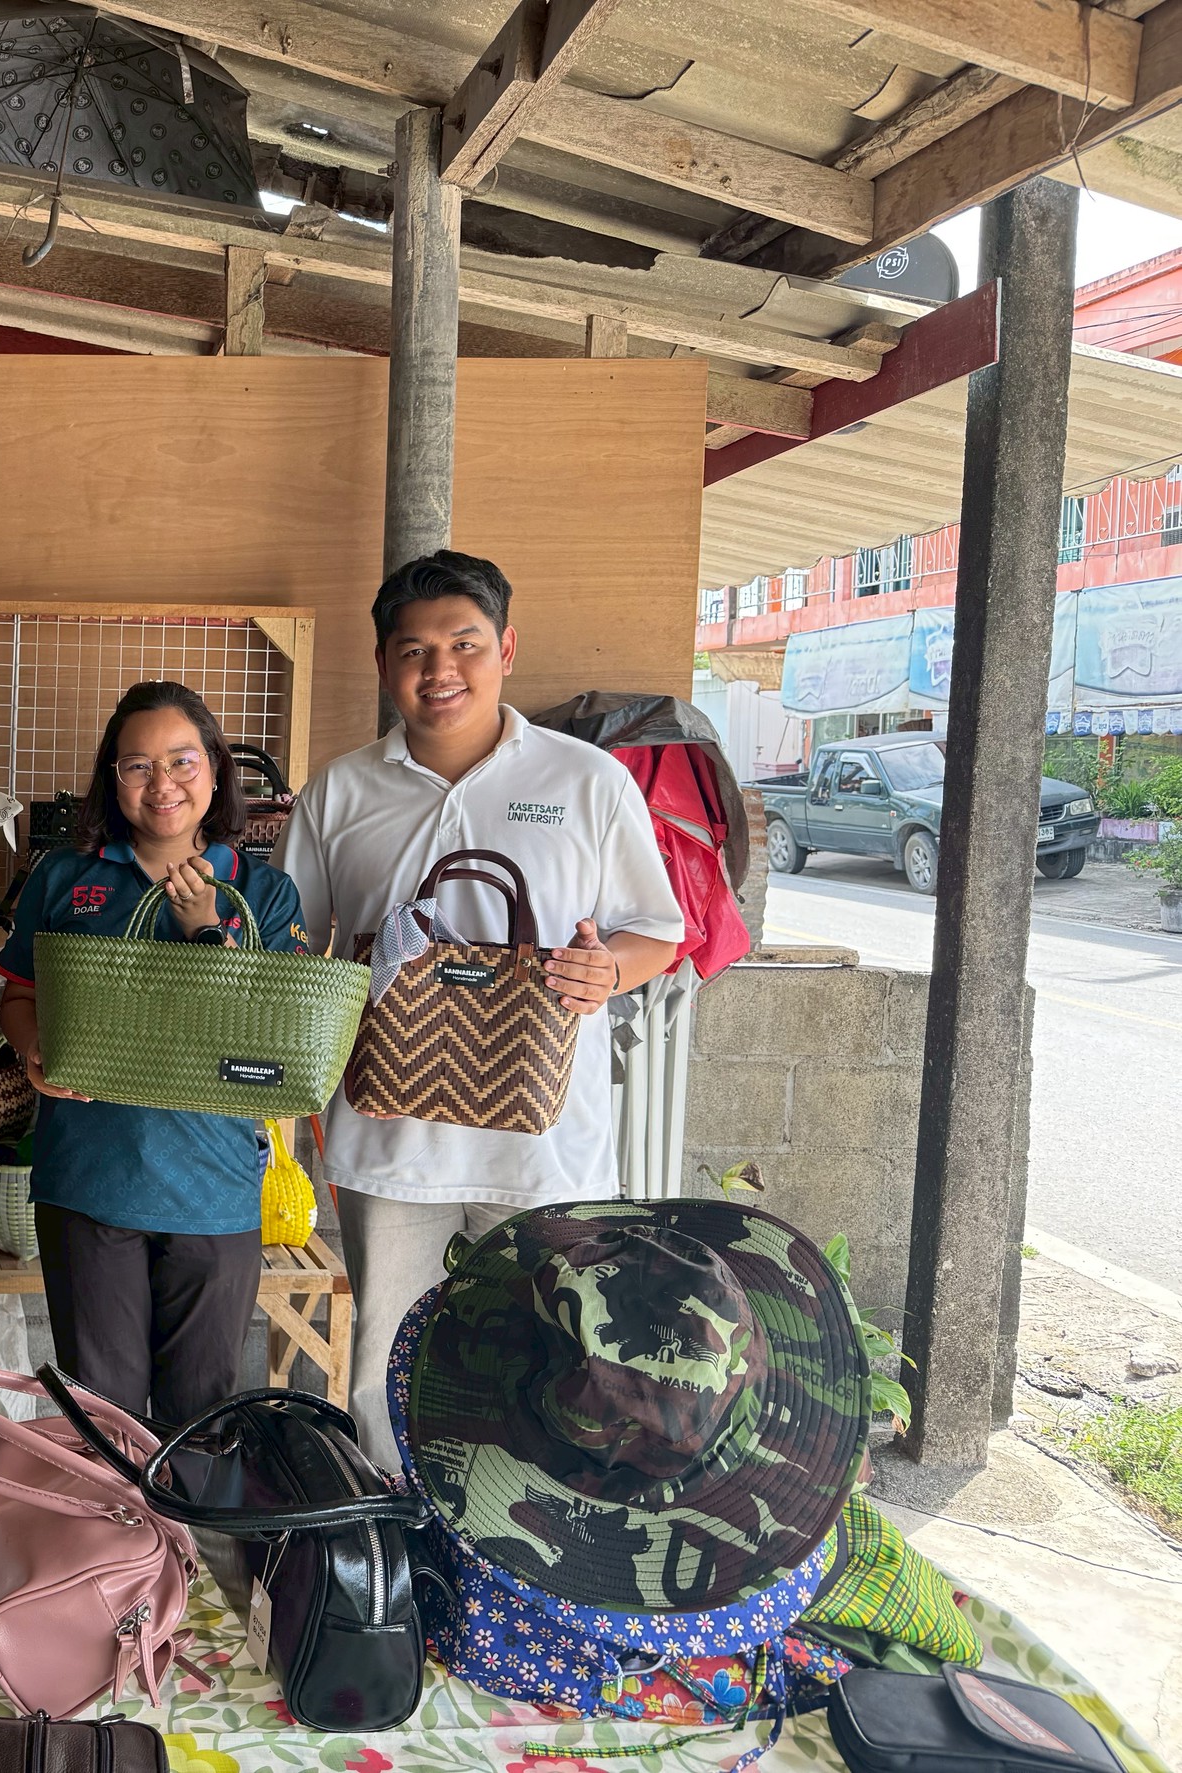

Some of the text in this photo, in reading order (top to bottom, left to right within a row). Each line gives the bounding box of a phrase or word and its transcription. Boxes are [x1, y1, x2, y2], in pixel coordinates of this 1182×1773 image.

[885, 258, 901, 267] PSI
[508, 802, 565, 815] KASETSART
[507, 812, 564, 825] UNIVERSITY
[74, 905, 100, 915] DOAE
[443, 967, 487, 978] BANNAILEAM
[230, 1064, 275, 1075] BANNAILEAM
[154, 1136, 184, 1167] DOAE
[147, 1167, 178, 1196] DOAE
[178, 1163, 208, 1194] DOAE
[172, 1193, 203, 1223] DOAE
[203, 1187, 230, 1218] DOAE
[659, 1374, 701, 1394] WASH
